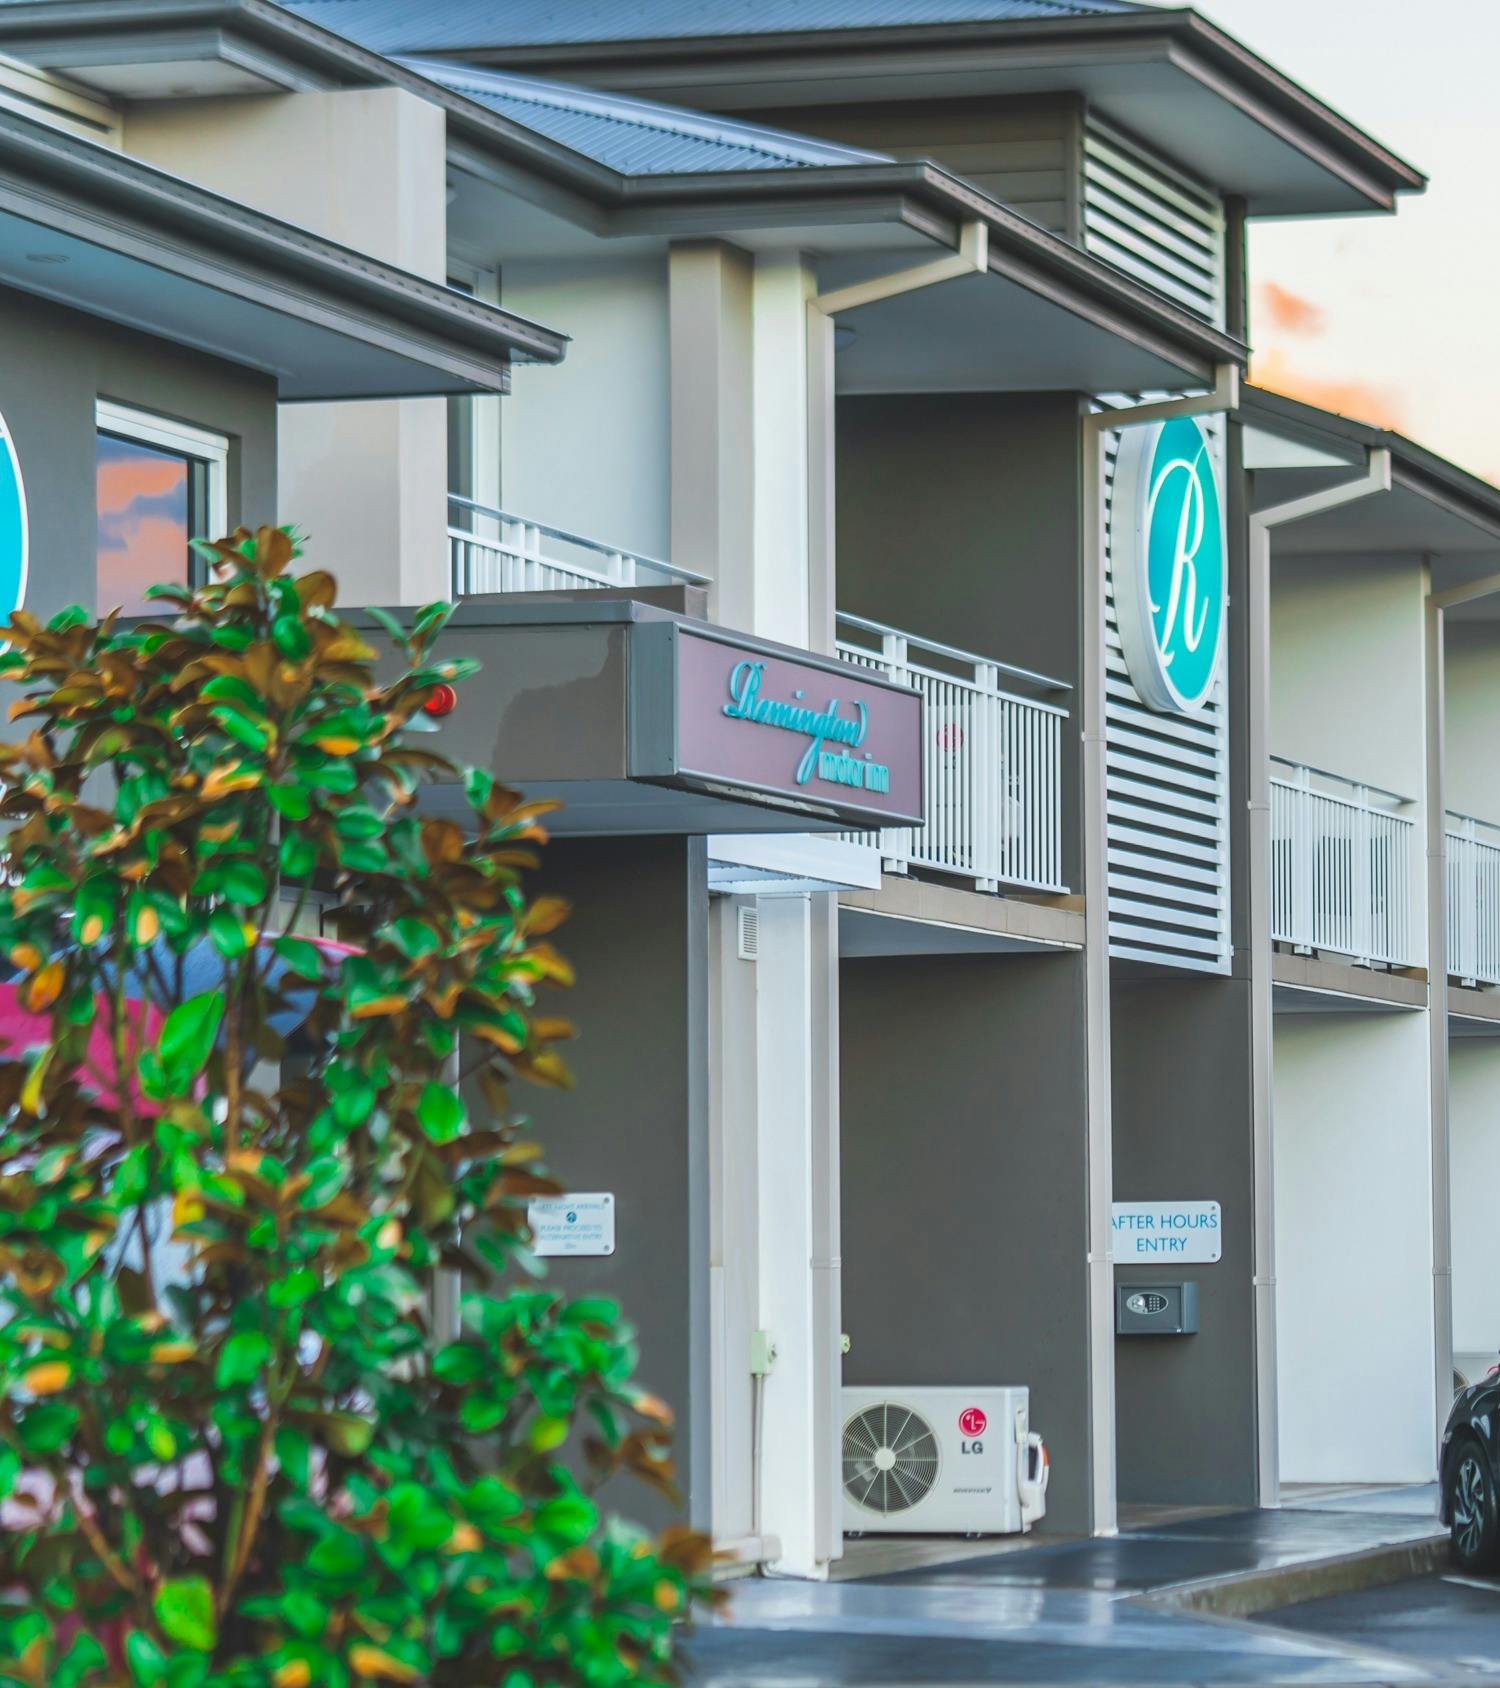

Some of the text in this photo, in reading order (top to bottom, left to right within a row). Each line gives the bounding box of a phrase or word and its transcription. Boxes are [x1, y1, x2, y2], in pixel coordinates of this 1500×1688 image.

[818, 750, 890, 793] motor inn
[1160, 1214, 1217, 1228] HOURS
[1136, 1237, 1187, 1252] ENTRY
[961, 1441, 983, 1455] LG
